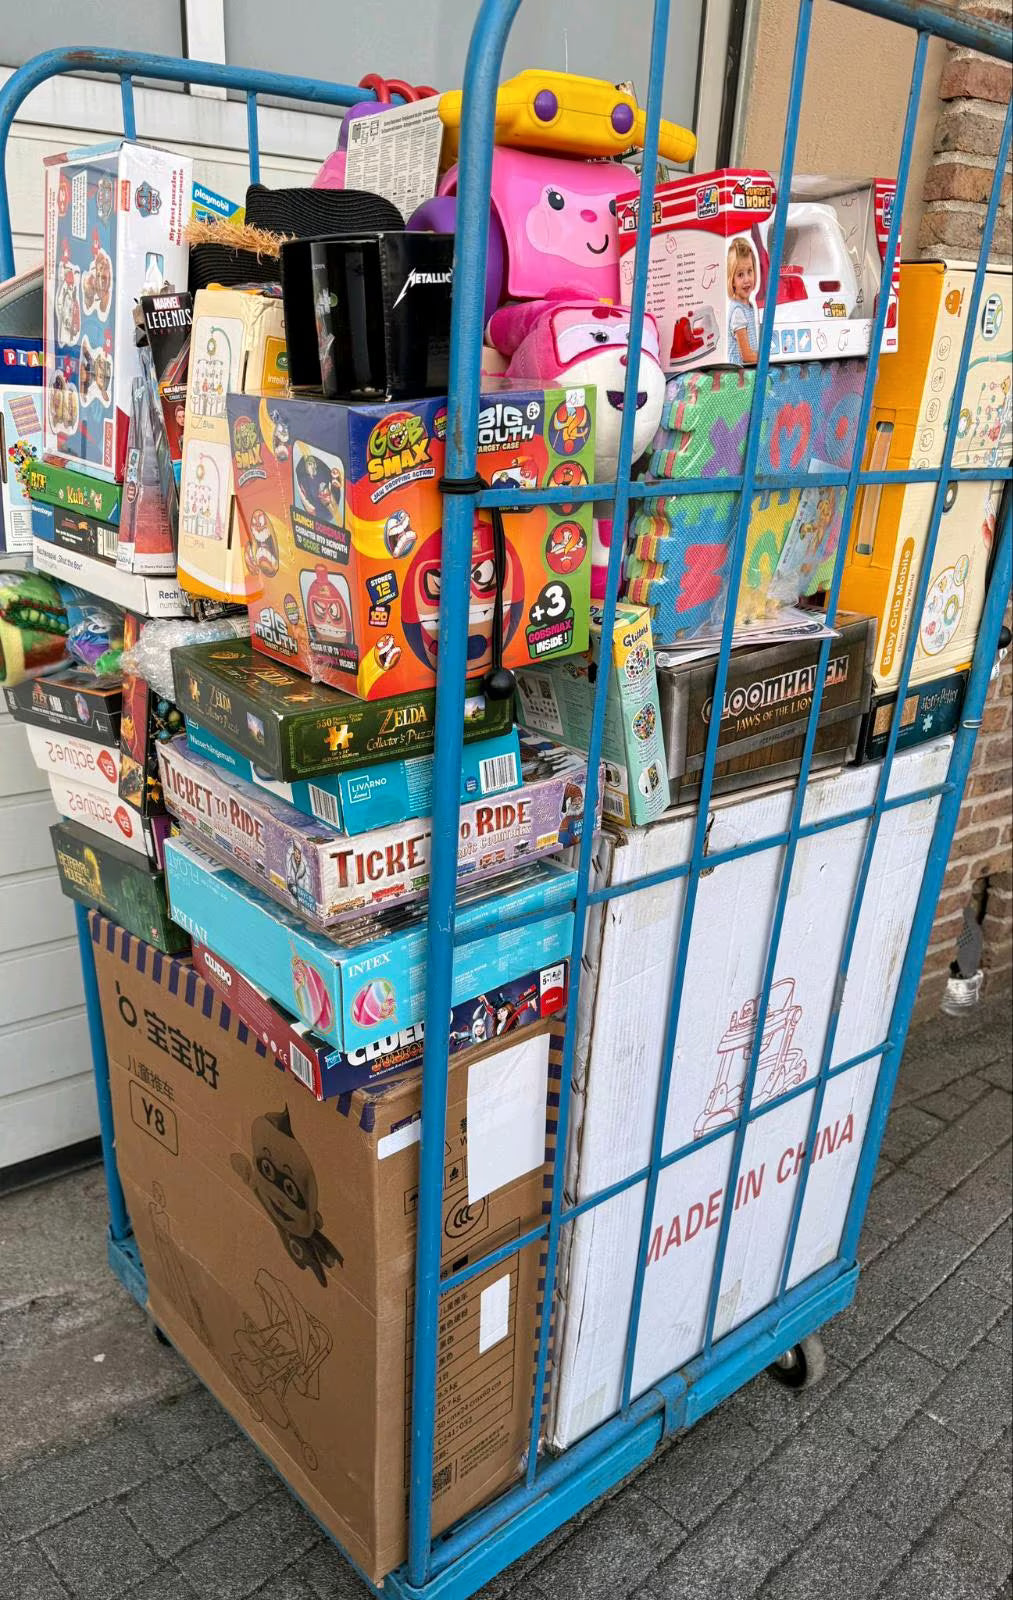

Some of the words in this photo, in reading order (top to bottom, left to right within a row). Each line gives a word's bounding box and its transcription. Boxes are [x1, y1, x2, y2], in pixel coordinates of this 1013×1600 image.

[193, 187, 230, 214] playmobil
[745, 195, 770, 209] HOME
[746, 187, 771, 196] JUNIOR'S
[699, 208, 716, 216] PEOPLE
[392, 268, 450, 309] METALLIC
[152, 296, 181, 310] MARVEL
[146, 309, 192, 329] LEGENDS
[478, 404, 523, 428] BIG
[528, 408, 538, 417] 5+
[369, 415, 424, 457] GOB
[477, 425, 535, 444] OUTH
[502, 441, 520, 450] CASE
[235, 443, 263, 470] SMAX
[367, 438, 432, 483] SMAX
[373, 489, 385, 501] JAW
[384, 473, 412, 490] DROPPING
[370, 573, 393, 587] STORES
[897, 547, 913, 591] Mobile
[159, 589, 179, 600] Rech
[376, 581, 391, 598] 12
[260, 607, 288, 636] BIG
[371, 611, 388, 622] 100
[889, 593, 904, 624] Crib
[254, 622, 298, 653] MOUTH
[528, 619, 572, 643] GOBSMAX
[623, 623, 649, 648] Glitters
[882, 624, 898, 666] Baby
[377, 705, 428, 735] ZELDA
[736, 713, 761, 733] JAWS
[763, 710, 774, 721] OF
[775, 705, 789, 717] THE
[366, 733, 405, 751] Collector's
[405, 724, 434, 746] Puzzl
[351, 777, 388, 793] LIVARNO
[160, 752, 213, 818] TICKET
[214, 796, 228, 818] TO
[229, 796, 265, 848] RIDE
[460, 821, 471, 840] O
[475, 799, 532, 838] RIDE
[204, 952, 232, 987] CLUEDO
[347, 952, 391, 978] INTEX
[143, 1008, 220, 1090] 宝宝好
[347, 1021, 424, 1066] CLUED
[142, 1097, 166, 1136] Y8
[646, 1188, 723, 1267] MADE
[734, 1165, 765, 1211] IN
[776, 1113, 854, 1185] CHINA
